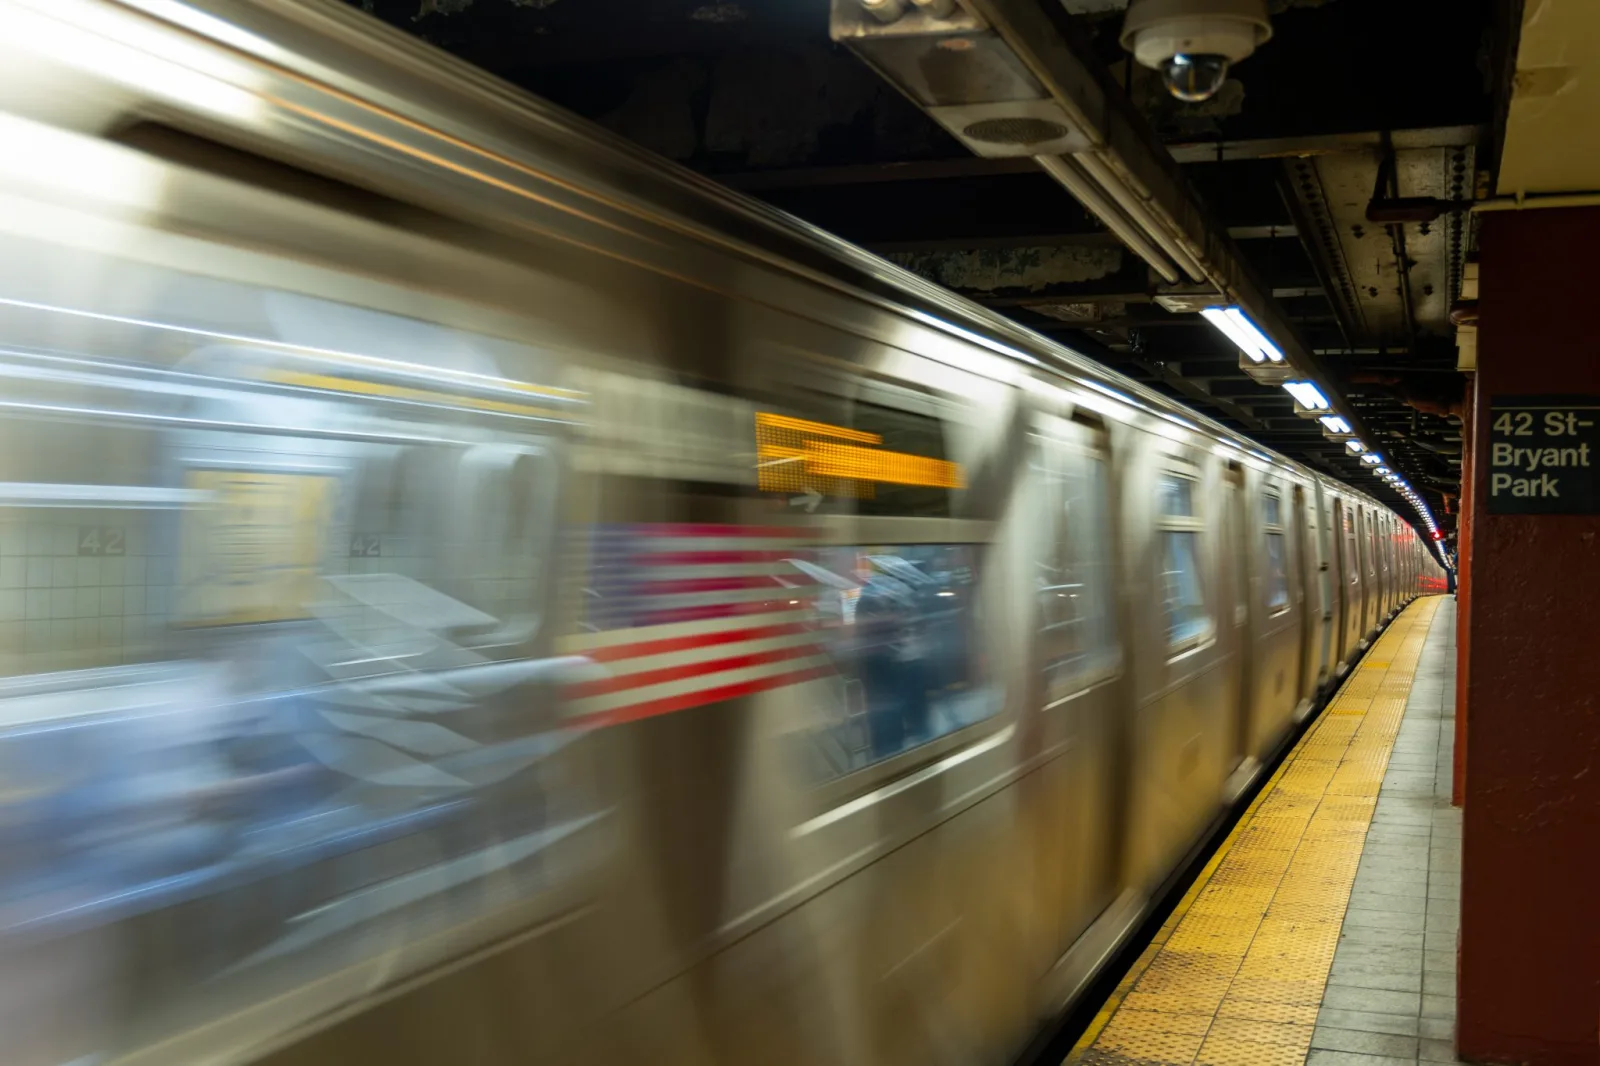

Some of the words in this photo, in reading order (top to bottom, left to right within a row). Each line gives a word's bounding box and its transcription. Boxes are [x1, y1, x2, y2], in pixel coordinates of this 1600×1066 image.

[1493, 412, 1533, 436] 42
[1492, 443, 1590, 472] Bryant
[1491, 473, 1560, 497] Park
[80, 528, 124, 553] 42
[351, 534, 380, 555] 42
